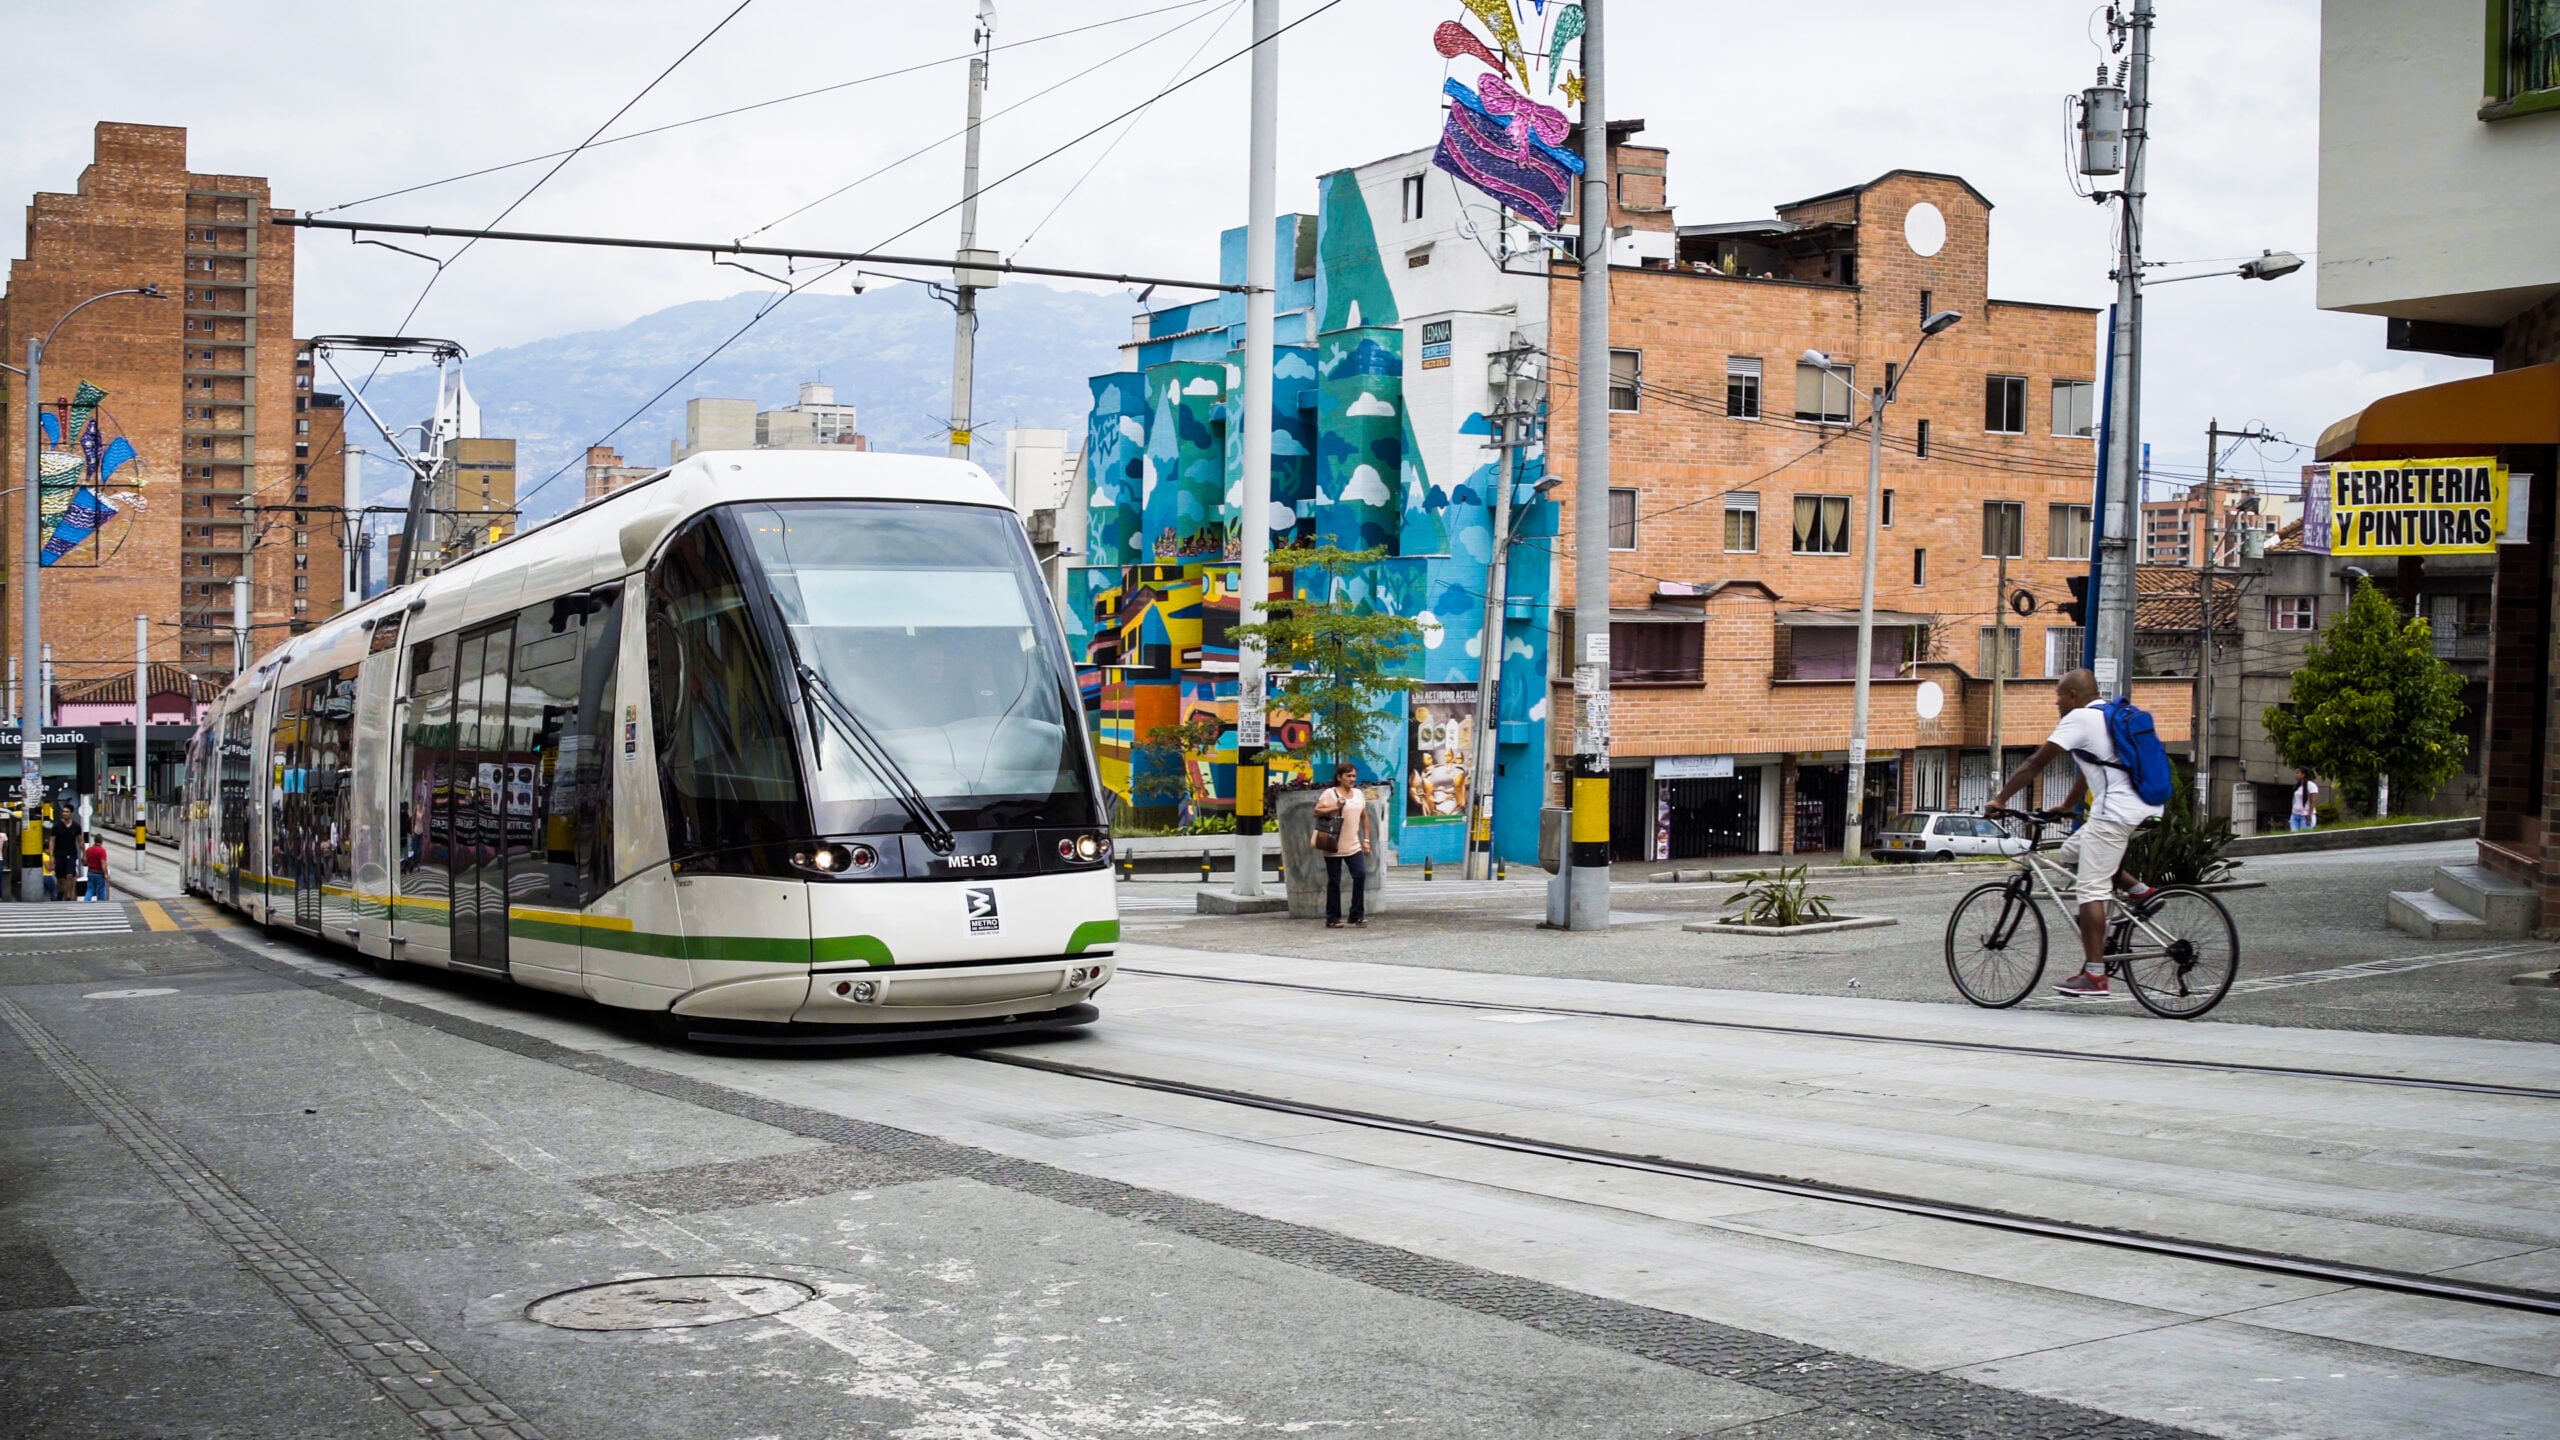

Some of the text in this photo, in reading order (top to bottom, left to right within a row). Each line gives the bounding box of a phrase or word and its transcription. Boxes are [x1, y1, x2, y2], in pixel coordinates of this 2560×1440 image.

[2336, 467, 2492, 506] FERRETERIA
[2336, 511, 2353, 546] Y
[2358, 508, 2492, 546] PINTURAS
[948, 855, 998, 868] ME1-03
[971, 919, 998, 927] METRO
